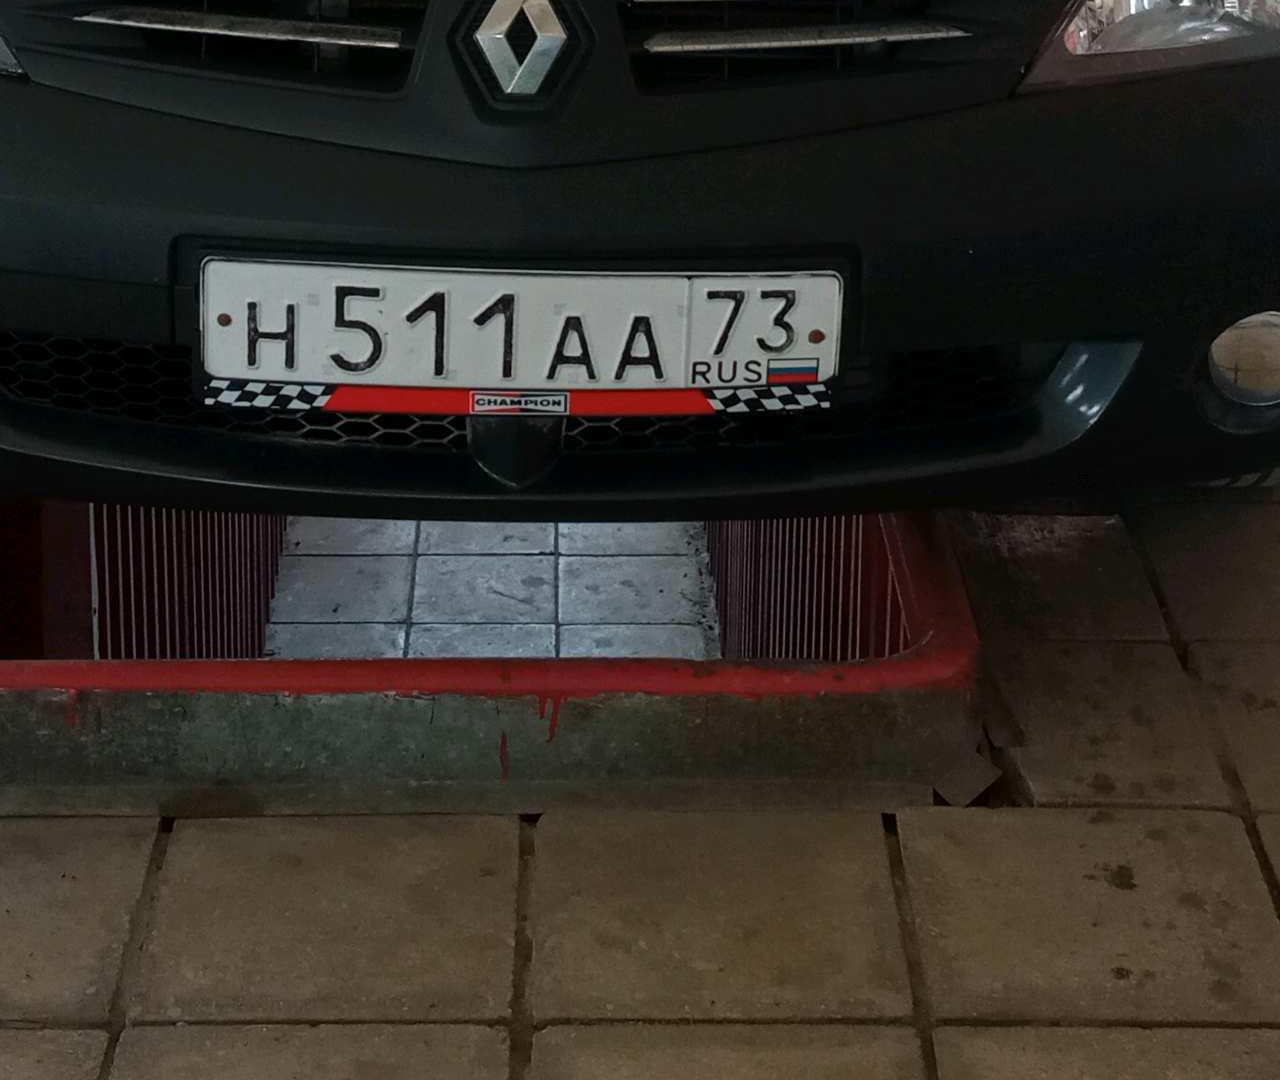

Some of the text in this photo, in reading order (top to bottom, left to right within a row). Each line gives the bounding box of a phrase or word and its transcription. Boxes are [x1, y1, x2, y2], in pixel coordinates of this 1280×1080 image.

[706, 289, 797, 356] 73
[691, 360, 763, 385] RUS
[475, 397, 562, 407] CHAMPION
